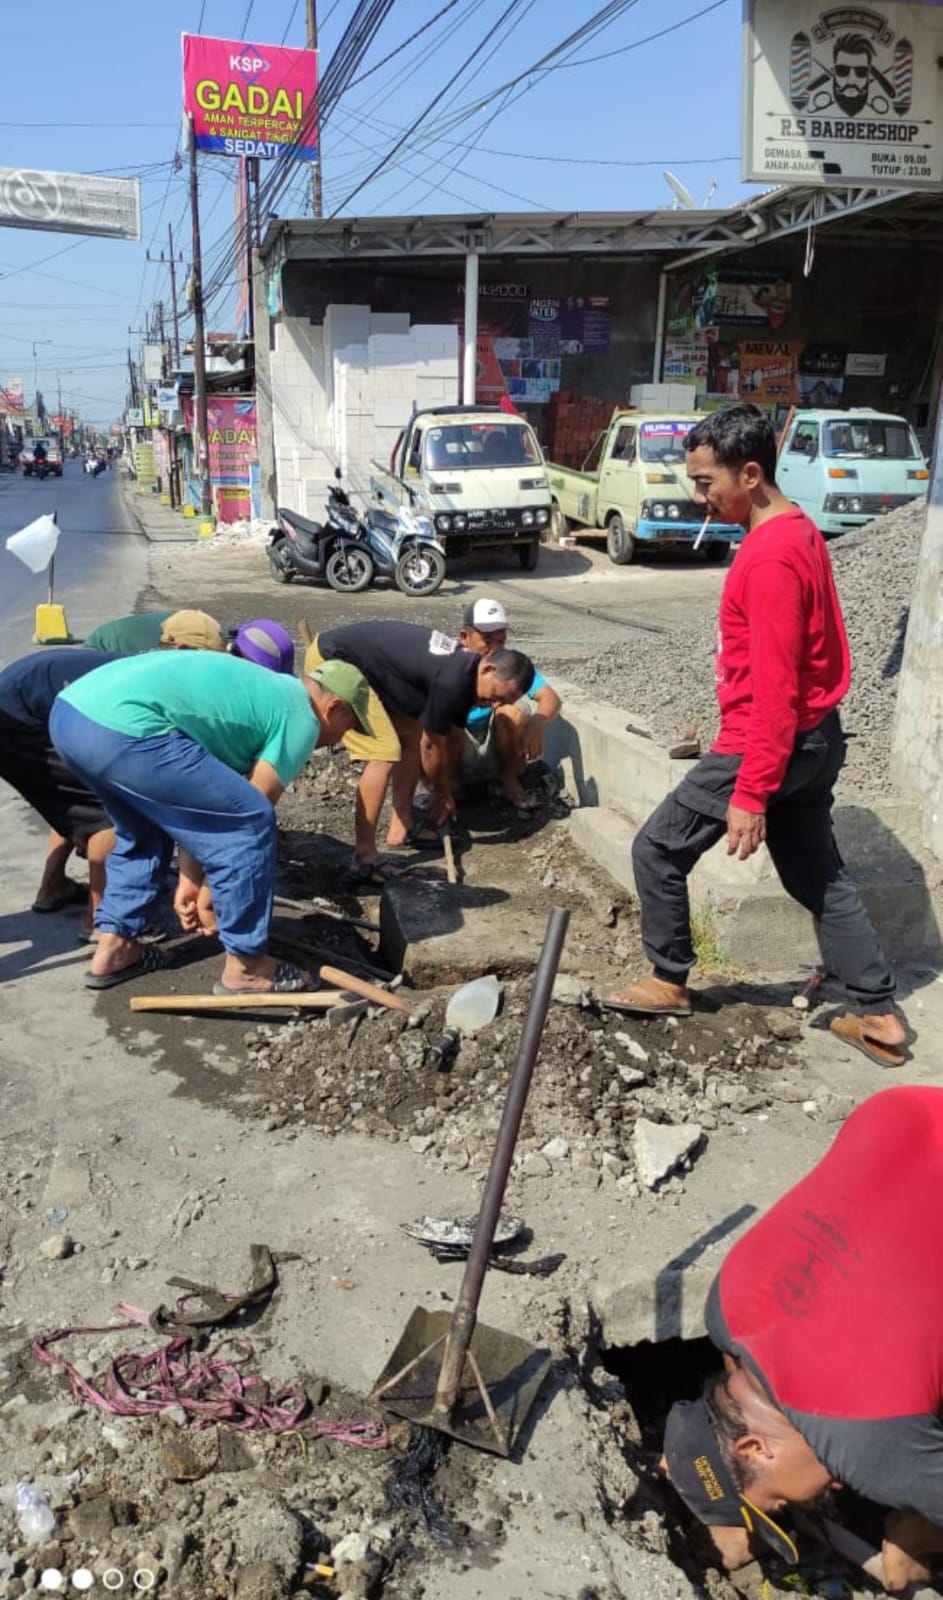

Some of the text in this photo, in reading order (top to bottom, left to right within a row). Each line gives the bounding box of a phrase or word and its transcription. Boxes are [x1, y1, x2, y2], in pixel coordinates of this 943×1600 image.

[229, 54, 263, 72] KSP
[195, 79, 304, 119] GADAI
[203, 113, 235, 125] AMAN
[209, 126, 217, 136] &
[219, 127, 262, 140] SANGAT
[780, 118, 919, 142] R.S BARBERSHOP
[224, 138, 279, 157] SEDATI
[764, 148, 802, 159] DEWASA
[871, 152, 896, 164] BUKA
[904, 154, 928, 165] 09.00
[764, 160, 816, 172] ANAK-ANAK
[871, 164, 901, 176] TUTUP
[908, 166, 932, 177] 23.00
[745, 343, 791, 356] MEVAL
